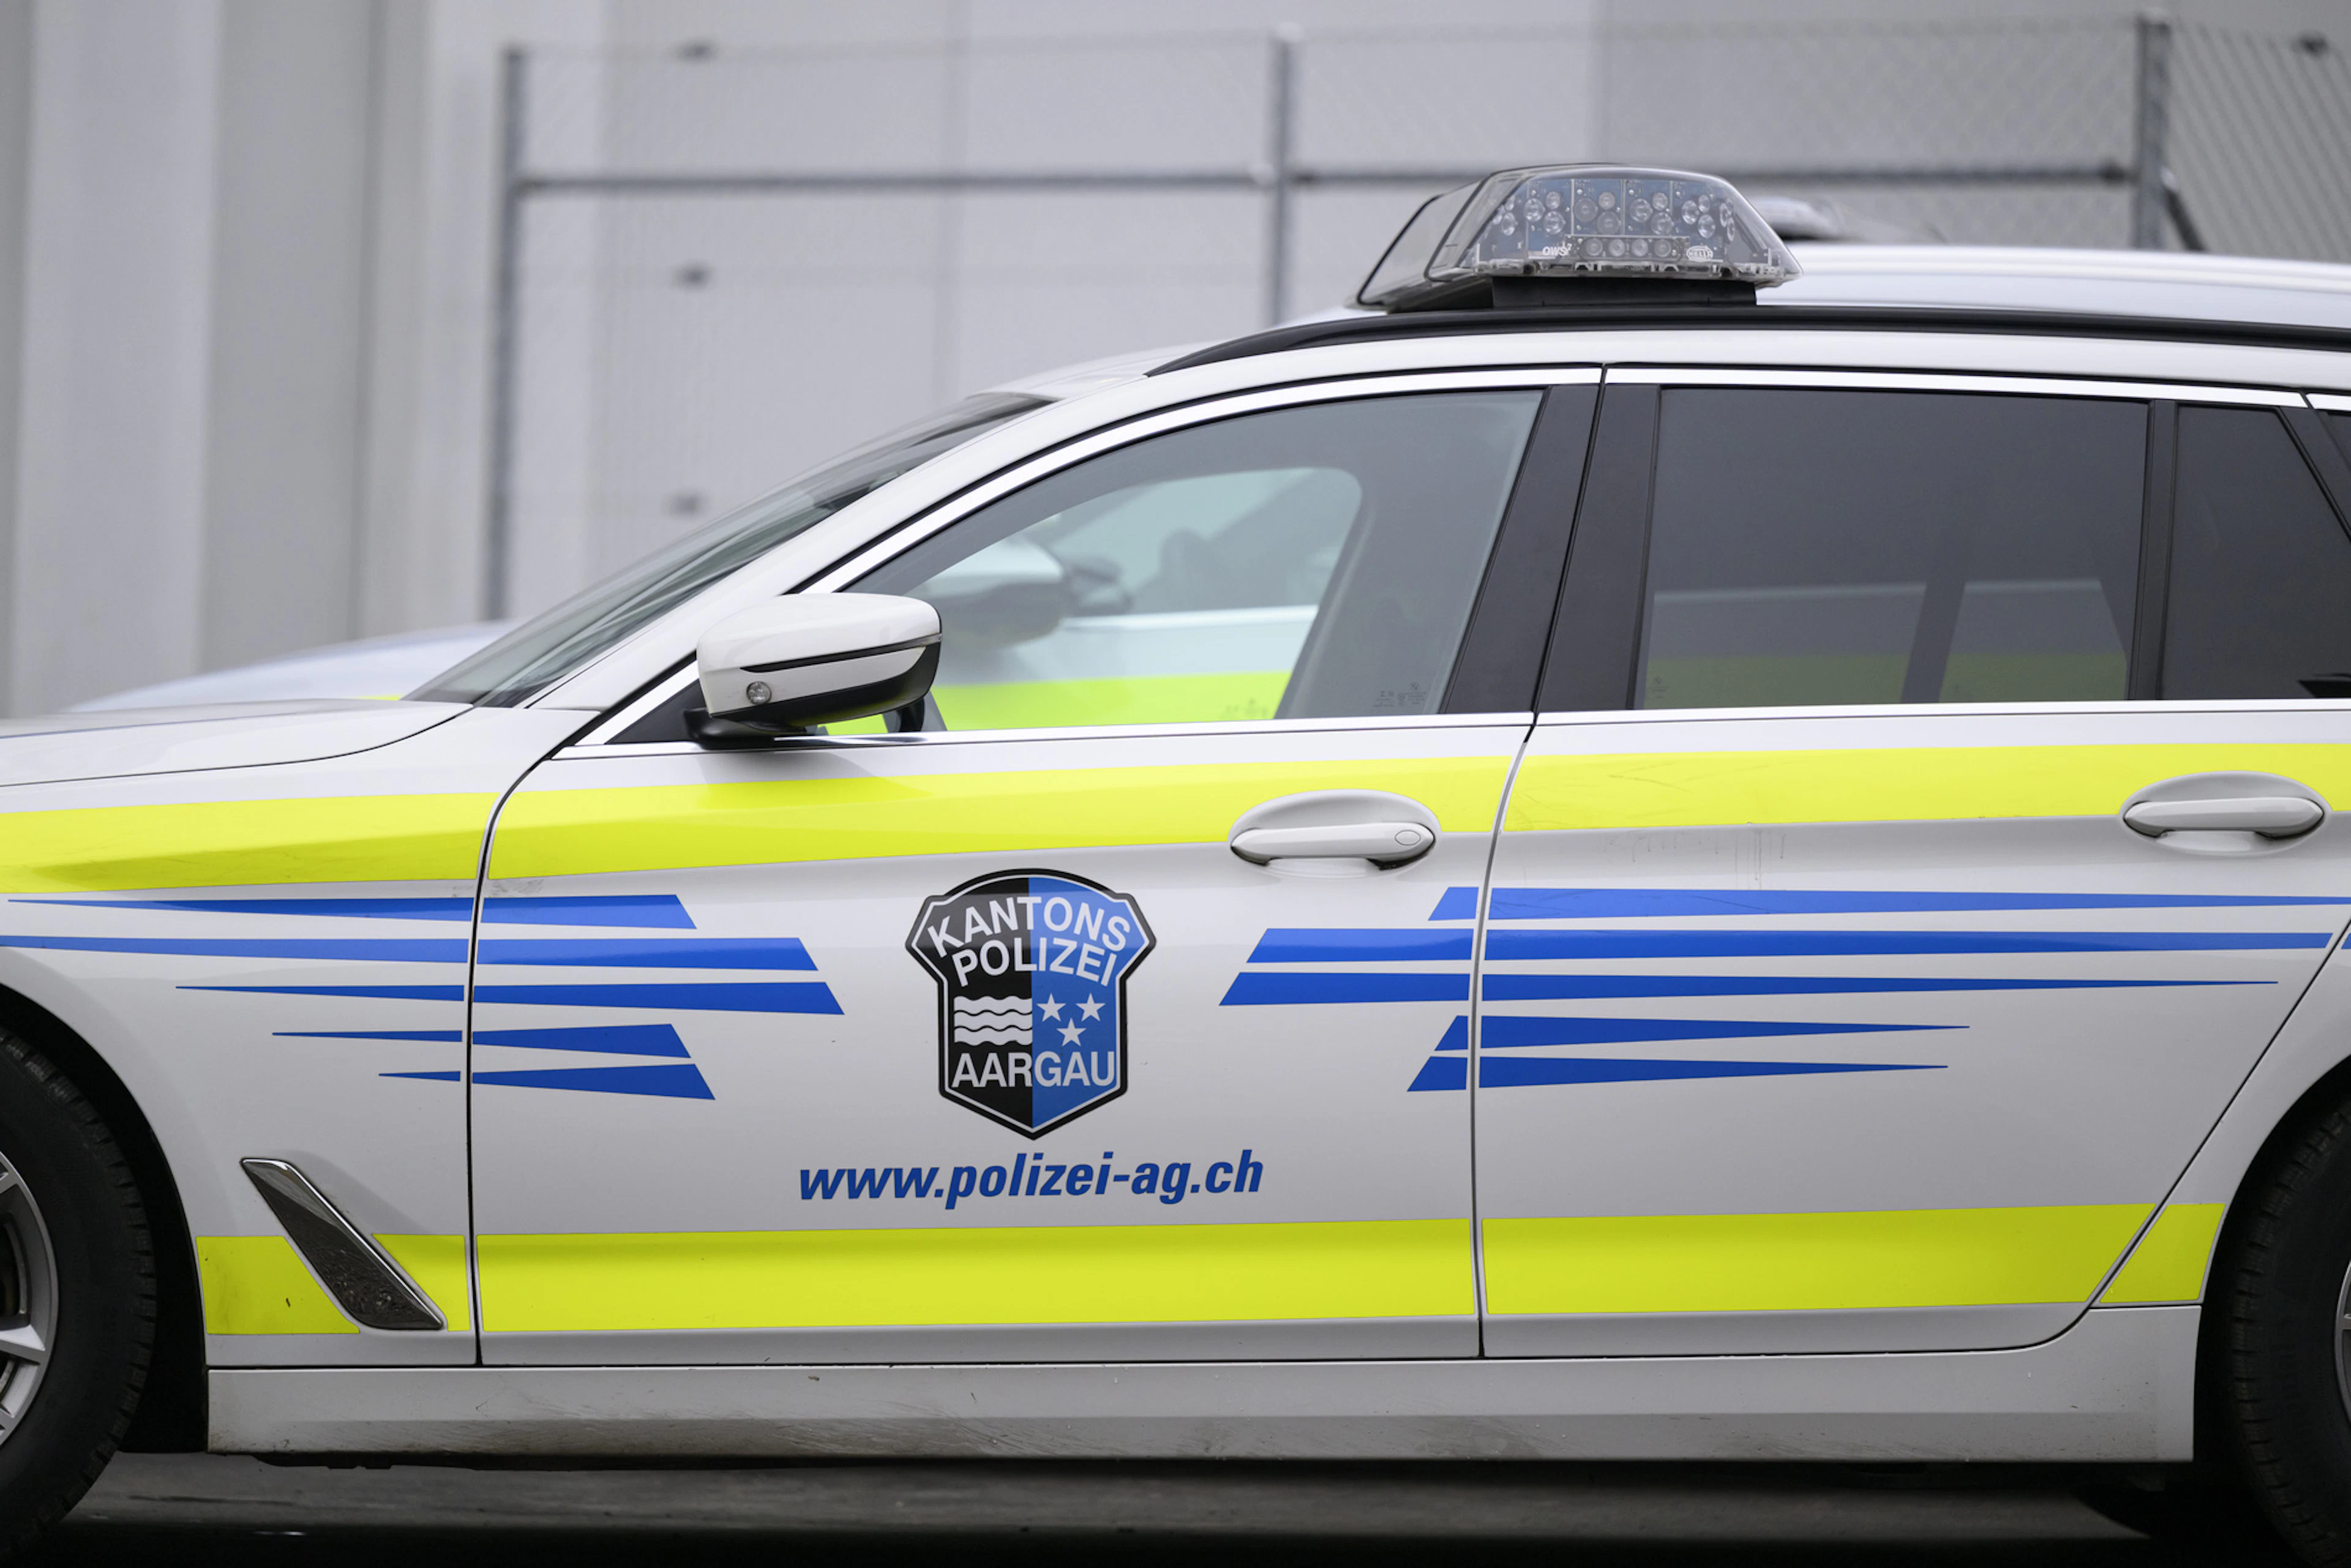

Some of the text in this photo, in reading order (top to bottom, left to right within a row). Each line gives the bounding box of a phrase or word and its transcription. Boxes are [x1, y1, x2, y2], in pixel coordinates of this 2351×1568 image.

[927, 896, 1131, 958] KANTONS
[951, 937, 1117, 988] POLIZEI
[951, 1051, 1116, 1088] AARGAU
[800, 1149, 1264, 1209] www.polizei-ag.ch
